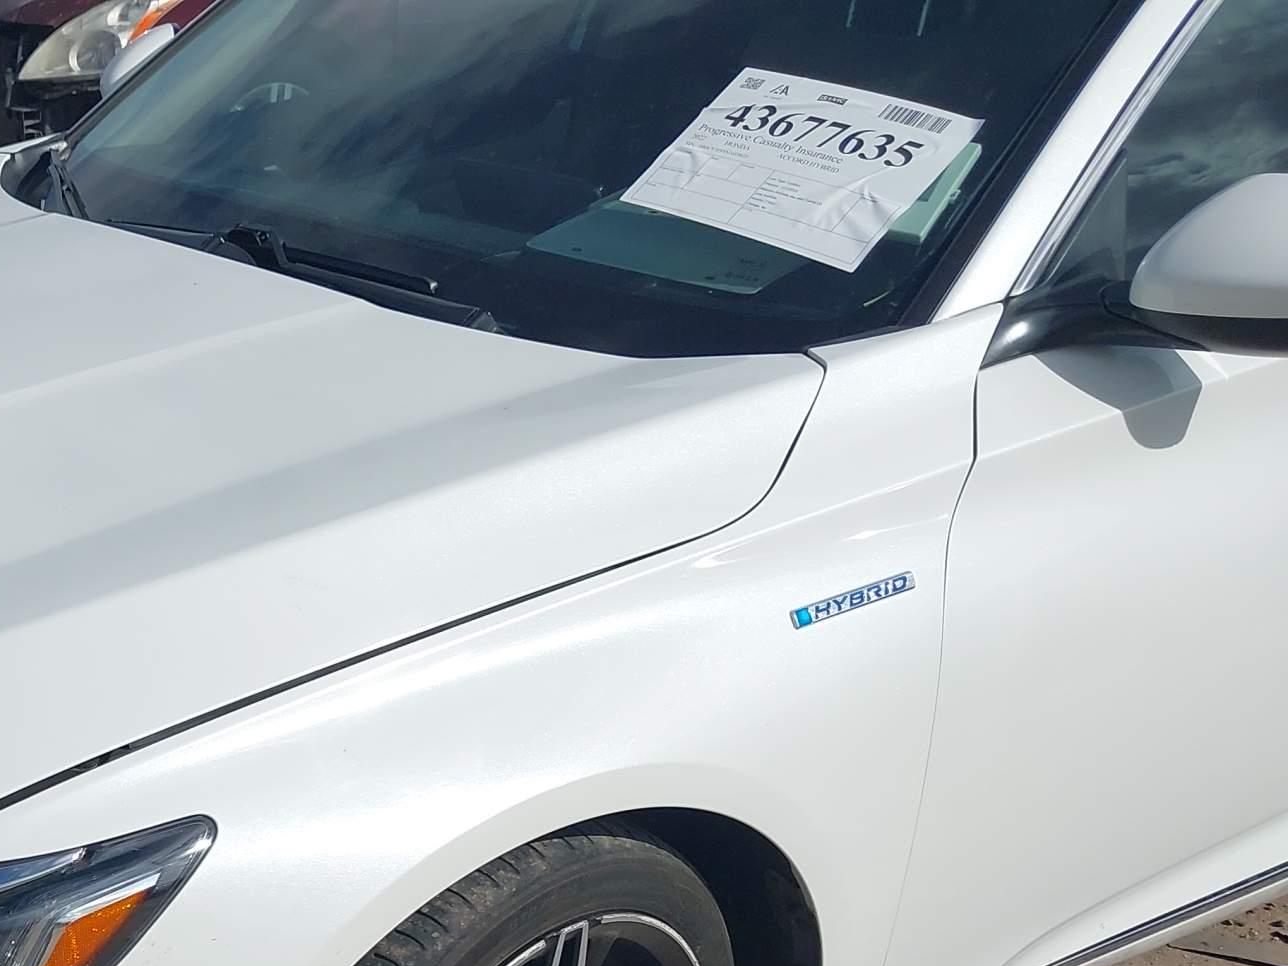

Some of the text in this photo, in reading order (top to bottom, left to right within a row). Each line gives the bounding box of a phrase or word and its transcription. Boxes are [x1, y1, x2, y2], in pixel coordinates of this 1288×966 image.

[698, 123, 751, 143] Progressive
[752, 135, 796, 152] Casualty
[795, 145, 844, 164] Insurance
[724, 104, 925, 167] 43677635
[814, 575, 908, 620] HYBRID
